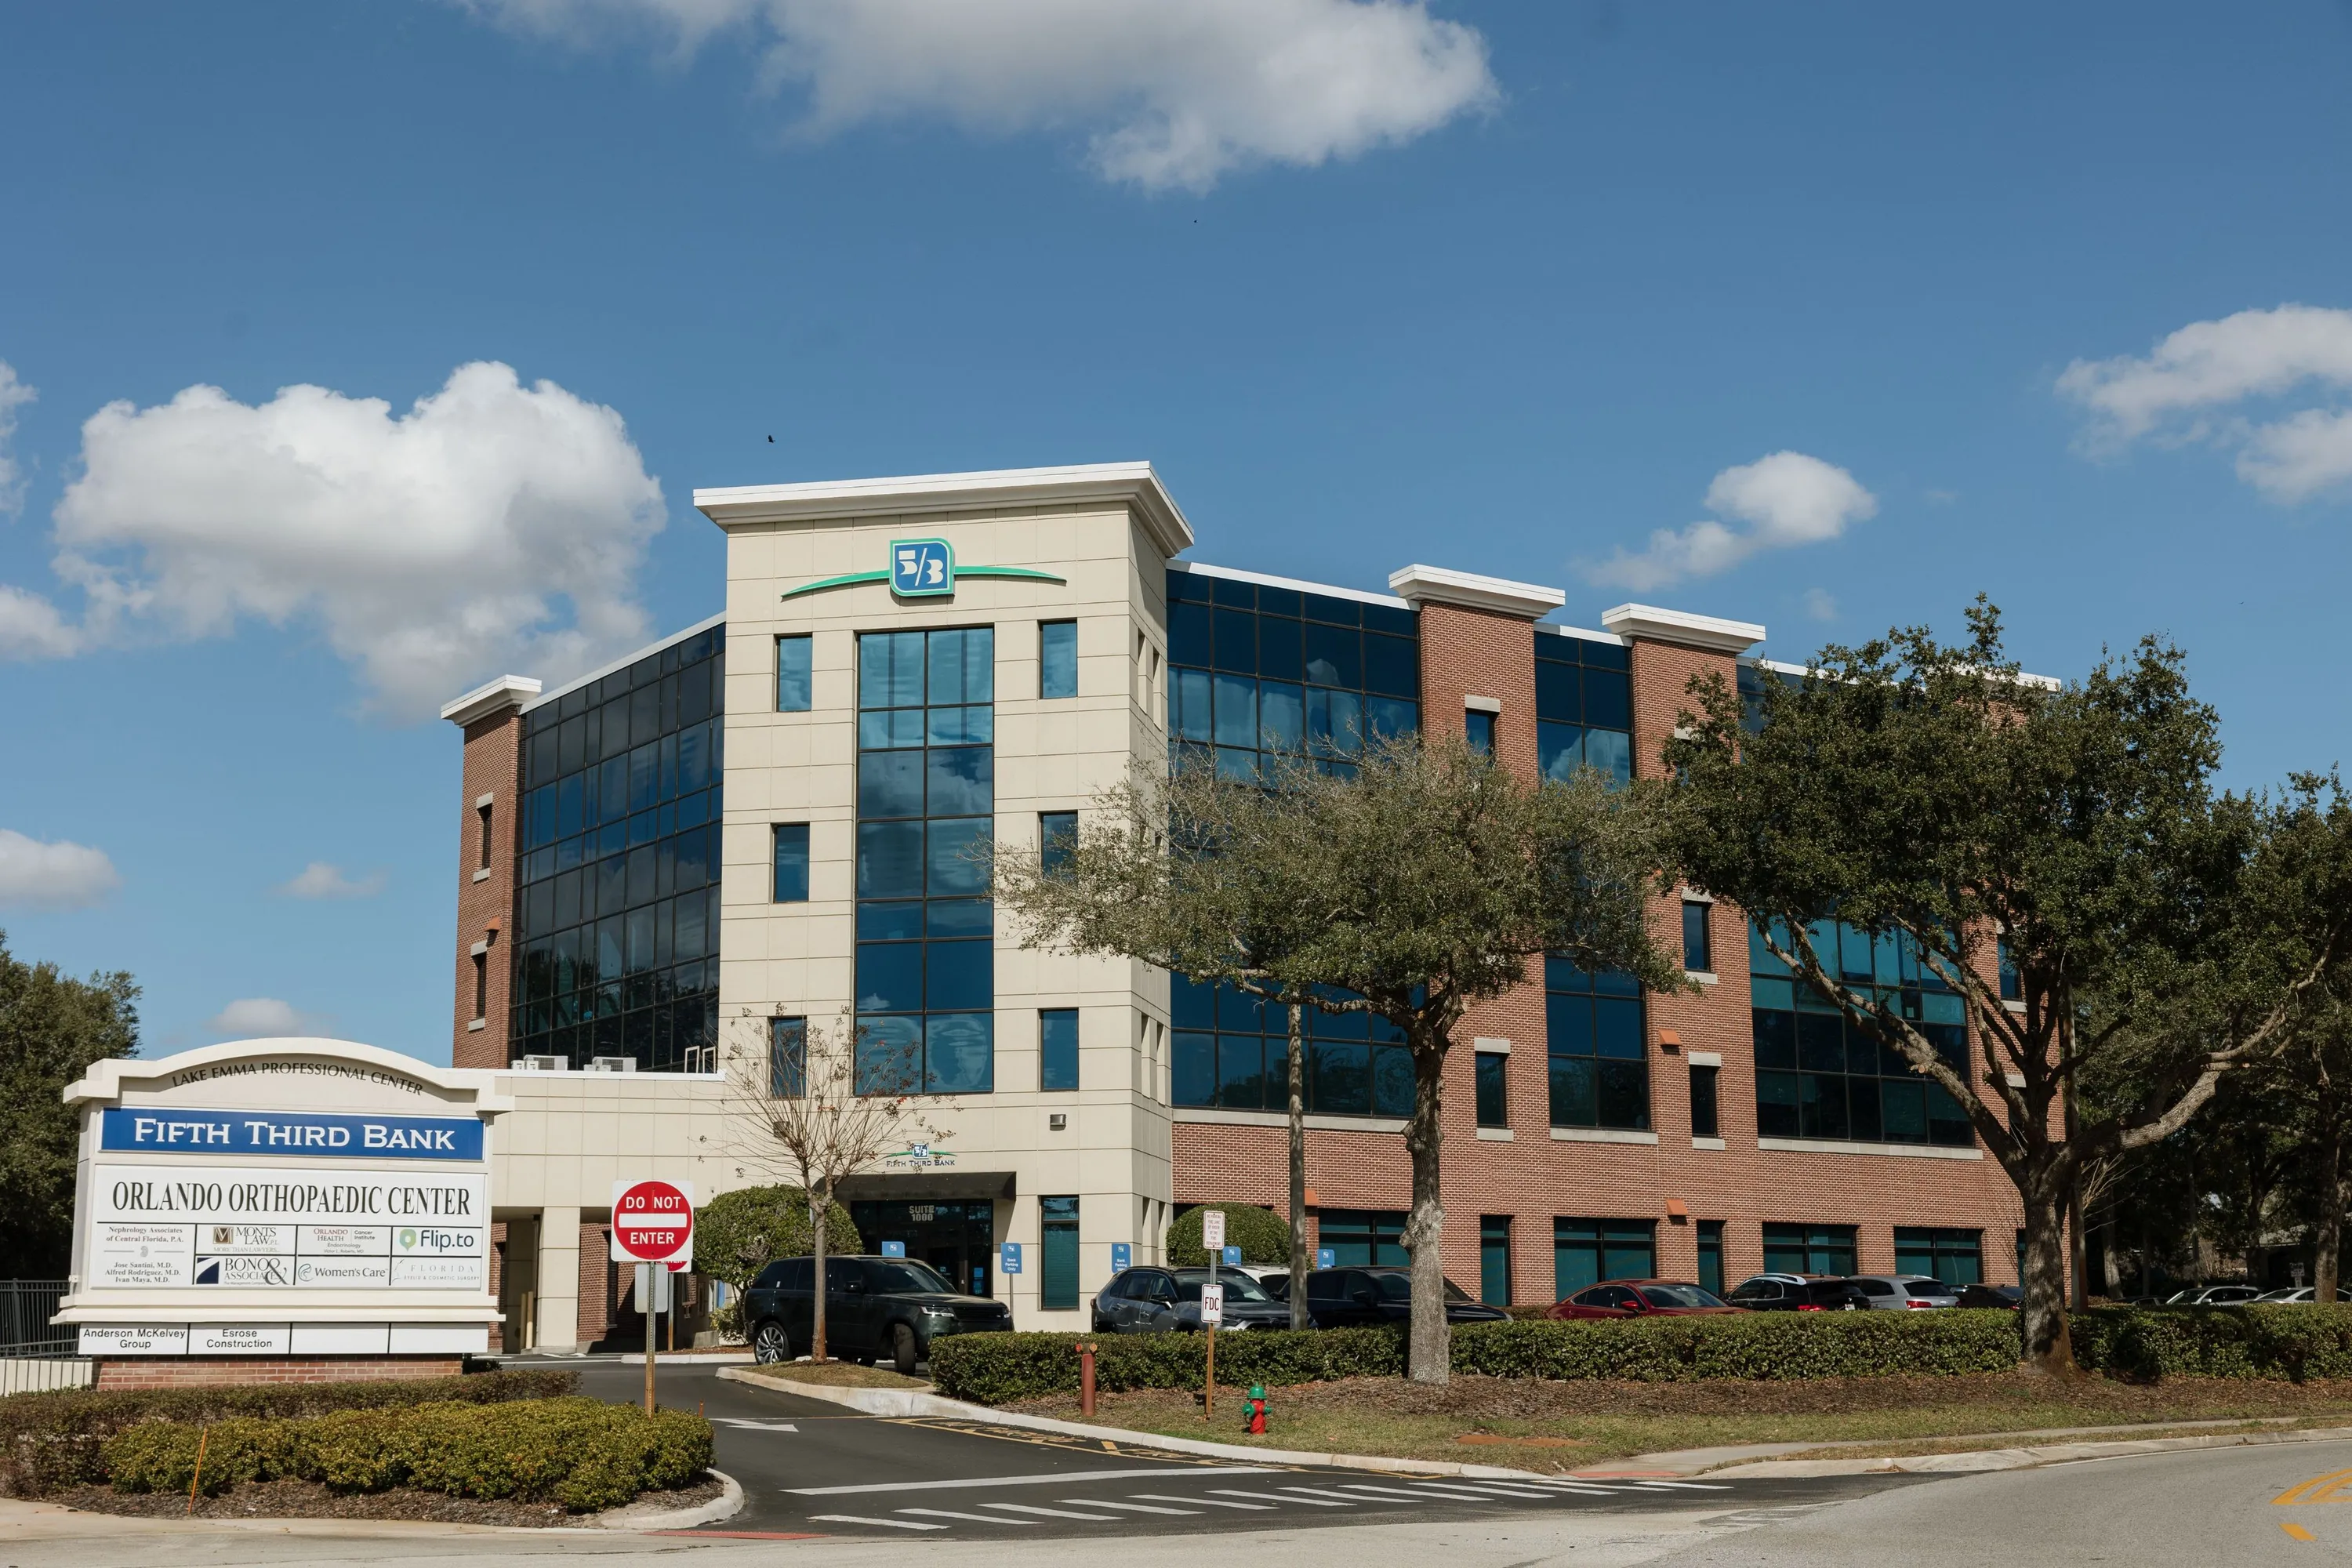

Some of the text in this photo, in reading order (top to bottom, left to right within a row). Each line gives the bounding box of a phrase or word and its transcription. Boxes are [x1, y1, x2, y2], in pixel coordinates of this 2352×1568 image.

[172, 1062, 423, 1096] LAKE EMMA PROFESSIONAL CENTER
[112, 1181, 471, 1215] ORLANDO ORTHOPAEDIC CENTER
[626, 1196, 681, 1209] DO NOT
[909, 1205, 935, 1214] SUITE
[236, 1227, 277, 1237] MONTS
[420, 1230, 474, 1253] Flip.to
[630, 1232, 675, 1245] ENTER
[225, 1258, 270, 1271] BONO
[314, 1268, 361, 1277] Women's
[1204, 1296, 1220, 1311] FDC
[137, 1329, 185, 1339] McKelvey
[223, 1329, 257, 1338] Esrose
[119, 1340, 151, 1349] Group
[206, 1340, 273, 1348] Construction
